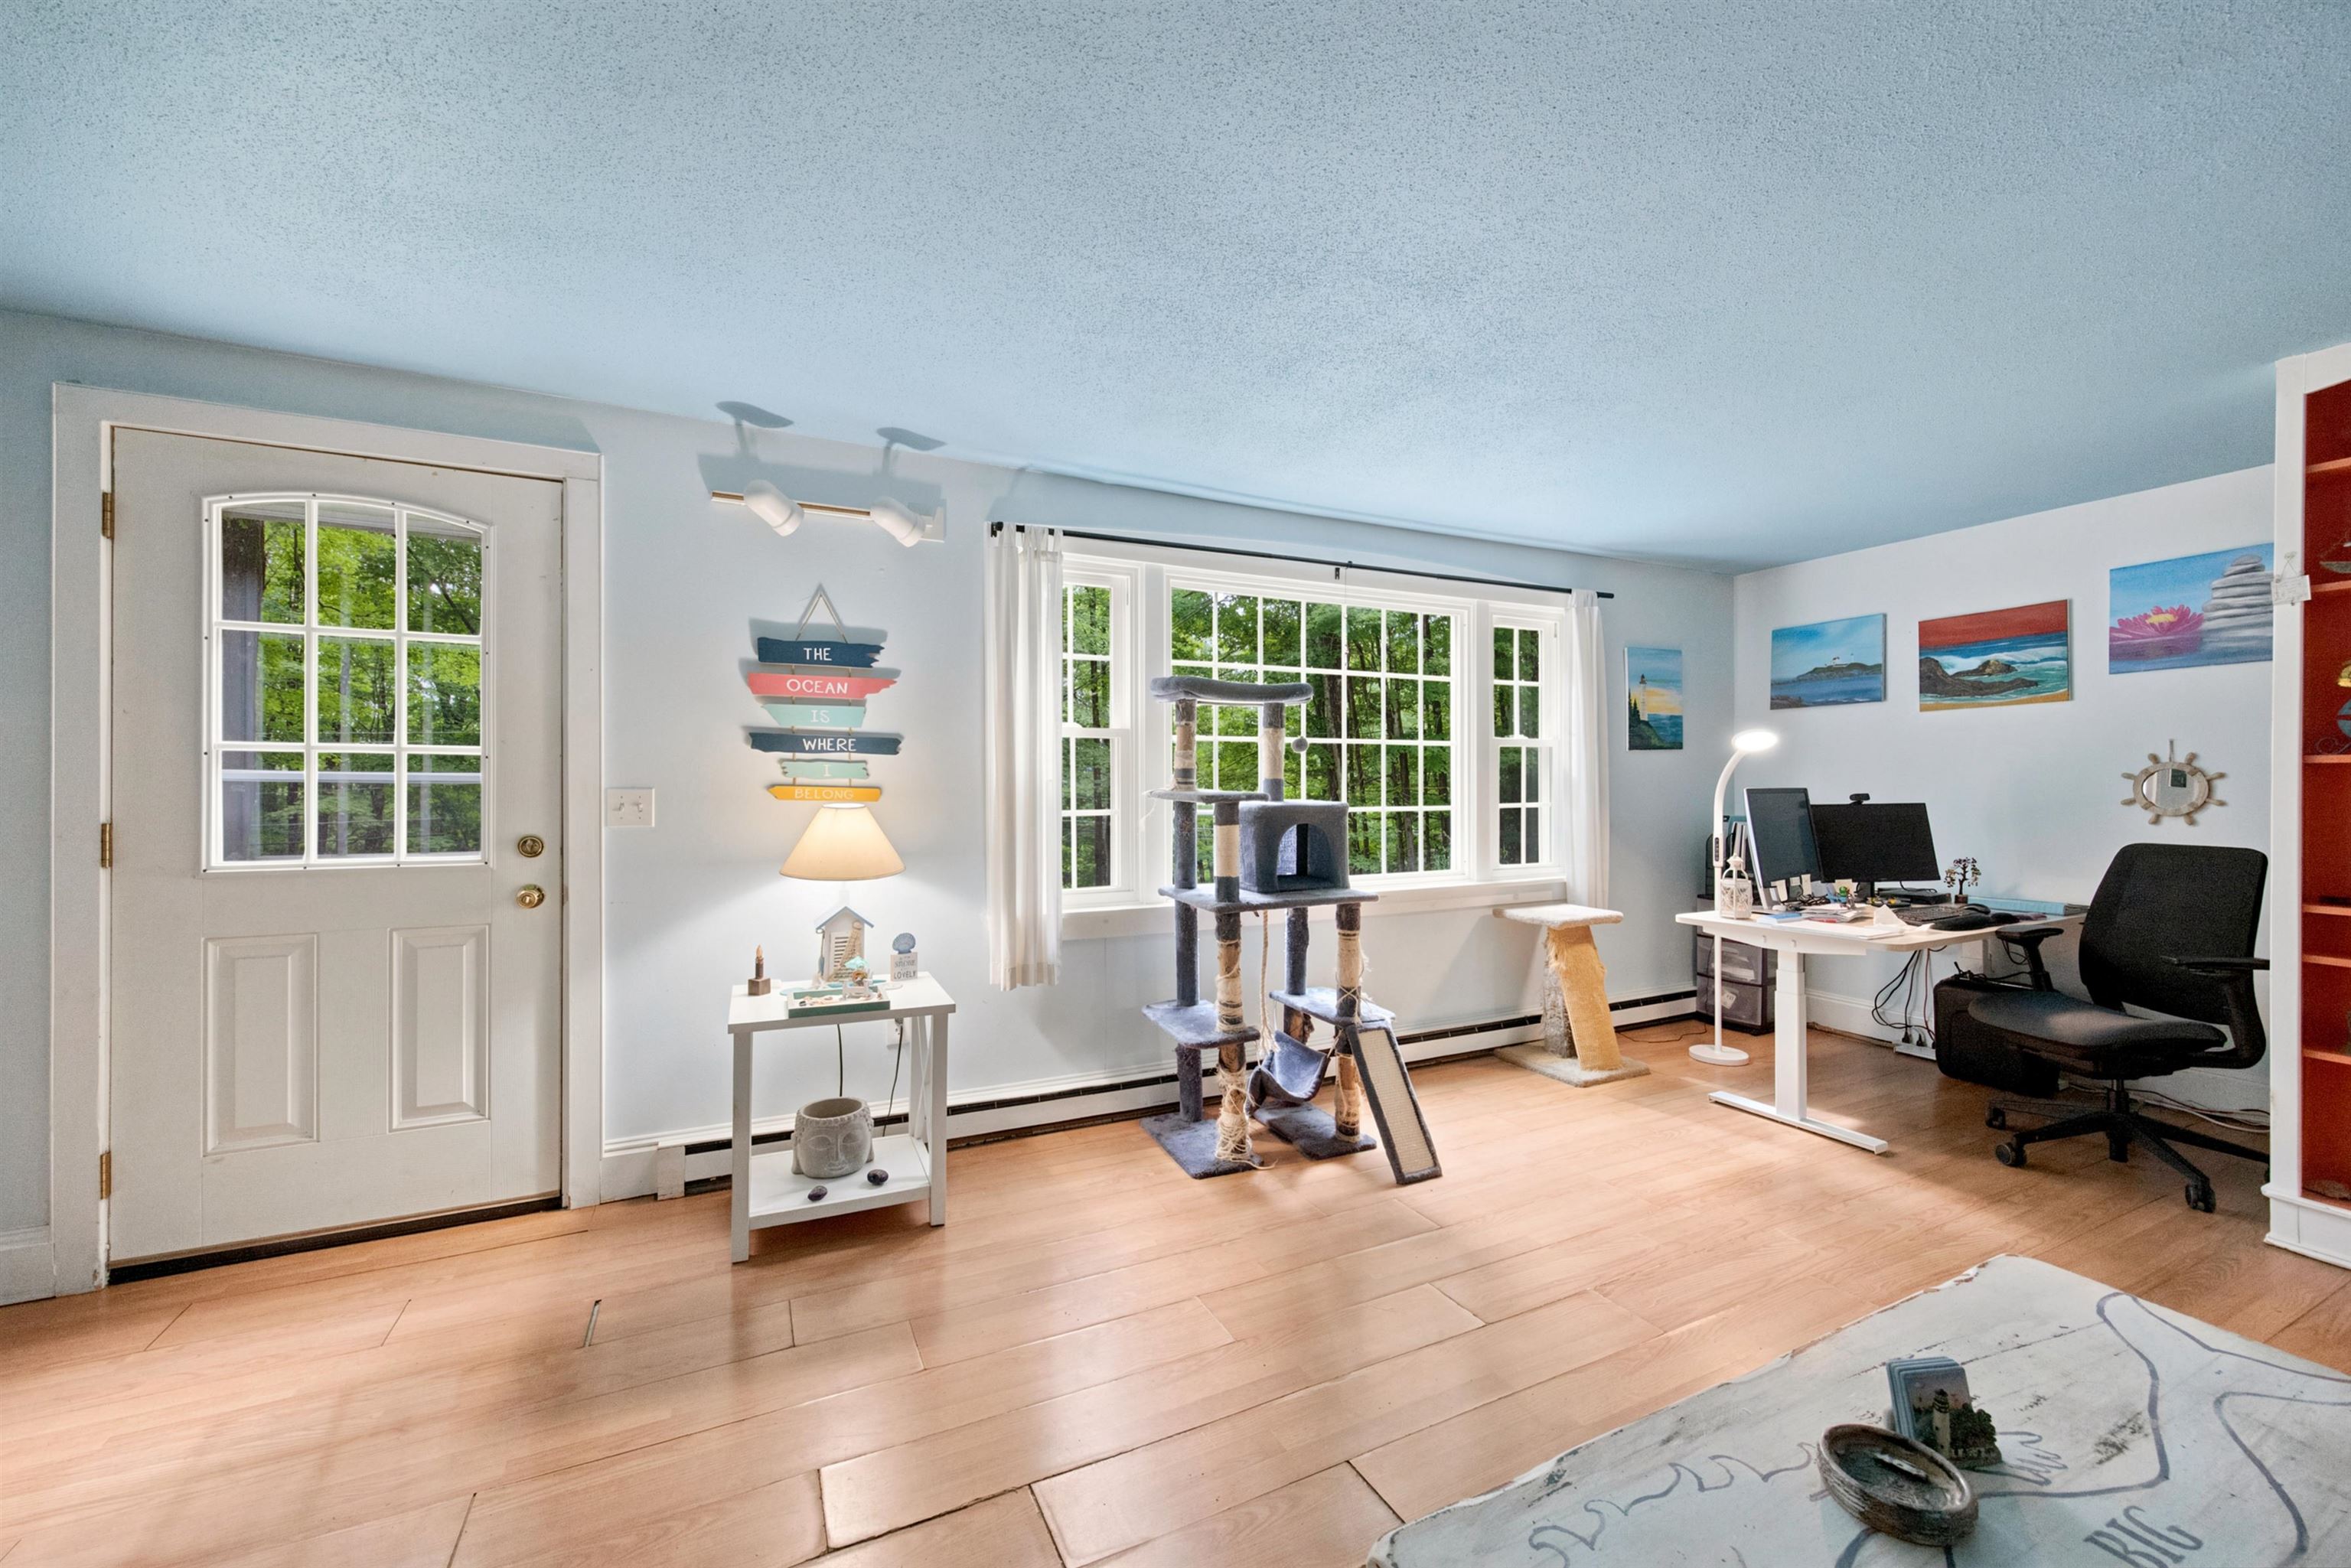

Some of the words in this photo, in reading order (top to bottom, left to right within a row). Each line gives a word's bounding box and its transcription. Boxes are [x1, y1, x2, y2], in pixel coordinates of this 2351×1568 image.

[804, 647, 833, 661] THE
[787, 679, 848, 694] OCEAN
[810, 709, 830, 723] IS
[802, 738, 856, 751] WHERE
[823, 764, 832, 777] I
[794, 788, 854, 800] BELONG
